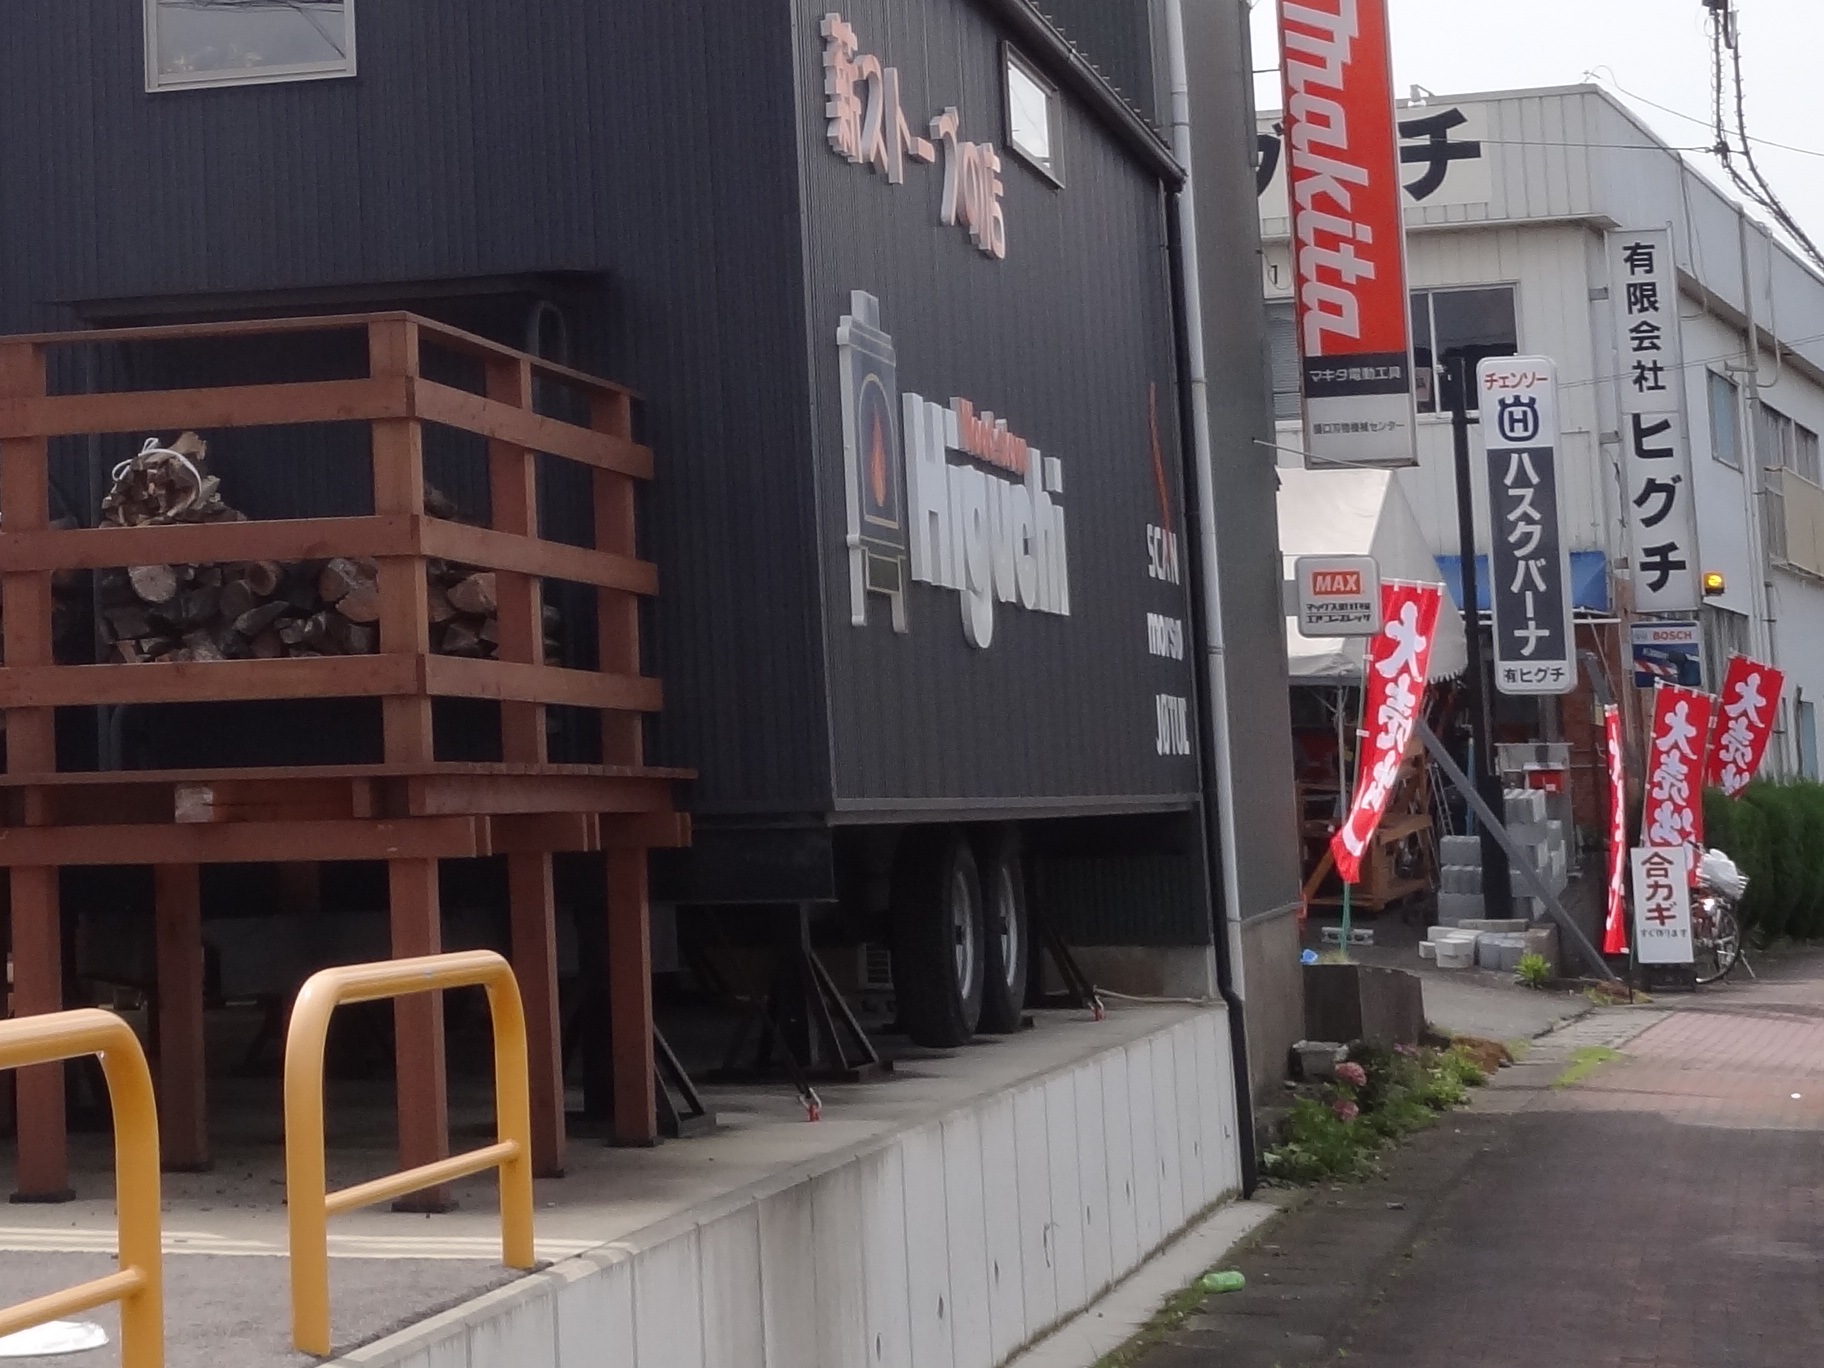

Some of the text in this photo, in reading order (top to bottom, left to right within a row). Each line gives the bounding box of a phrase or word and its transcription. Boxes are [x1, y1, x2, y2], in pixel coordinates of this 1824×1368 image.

[1309, 366, 1401, 382] マキタ電動工具
[1484, 371, 1548, 389] チェンソー
[902, 392, 1070, 648] Higuchi
[1503, 453, 1551, 657] ハスクバーナ
[1315, 574, 1358, 592] MAX
[1652, 631, 1692, 641] BOSCH
[1641, 851, 1677, 926] 合カギ
